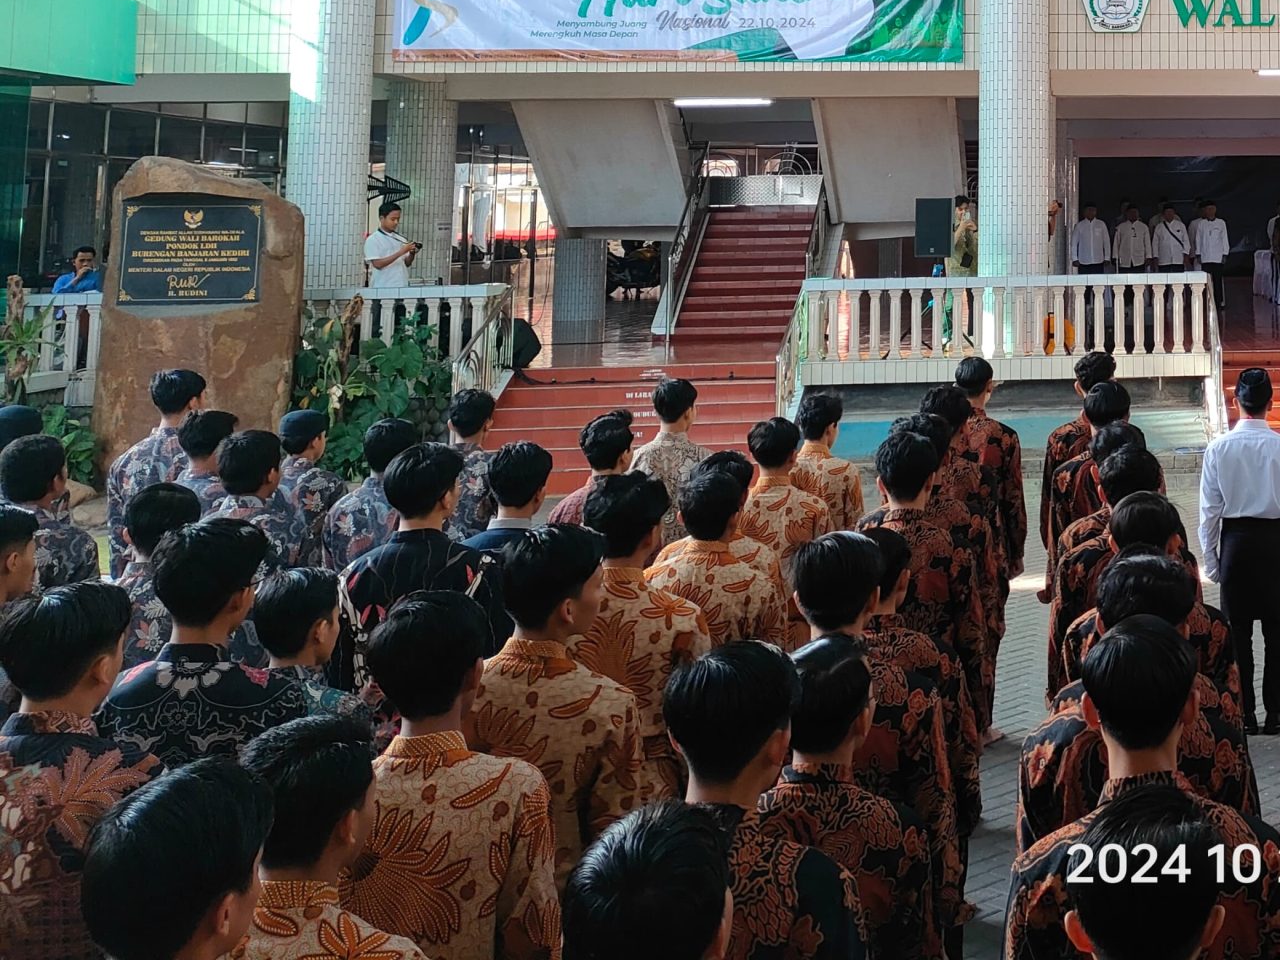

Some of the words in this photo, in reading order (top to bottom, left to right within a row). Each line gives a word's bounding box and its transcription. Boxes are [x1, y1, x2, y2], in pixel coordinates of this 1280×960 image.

[556, 20, 616, 30] Menyambung
[619, 19, 648, 30] Juang
[655, 9, 731, 32] Nasional
[738, 16, 817, 29] 22.10.2024
[530, 30, 581, 39] Merengkuh
[583, 30, 608, 38] Masa
[610, 29, 639, 40] Depan
